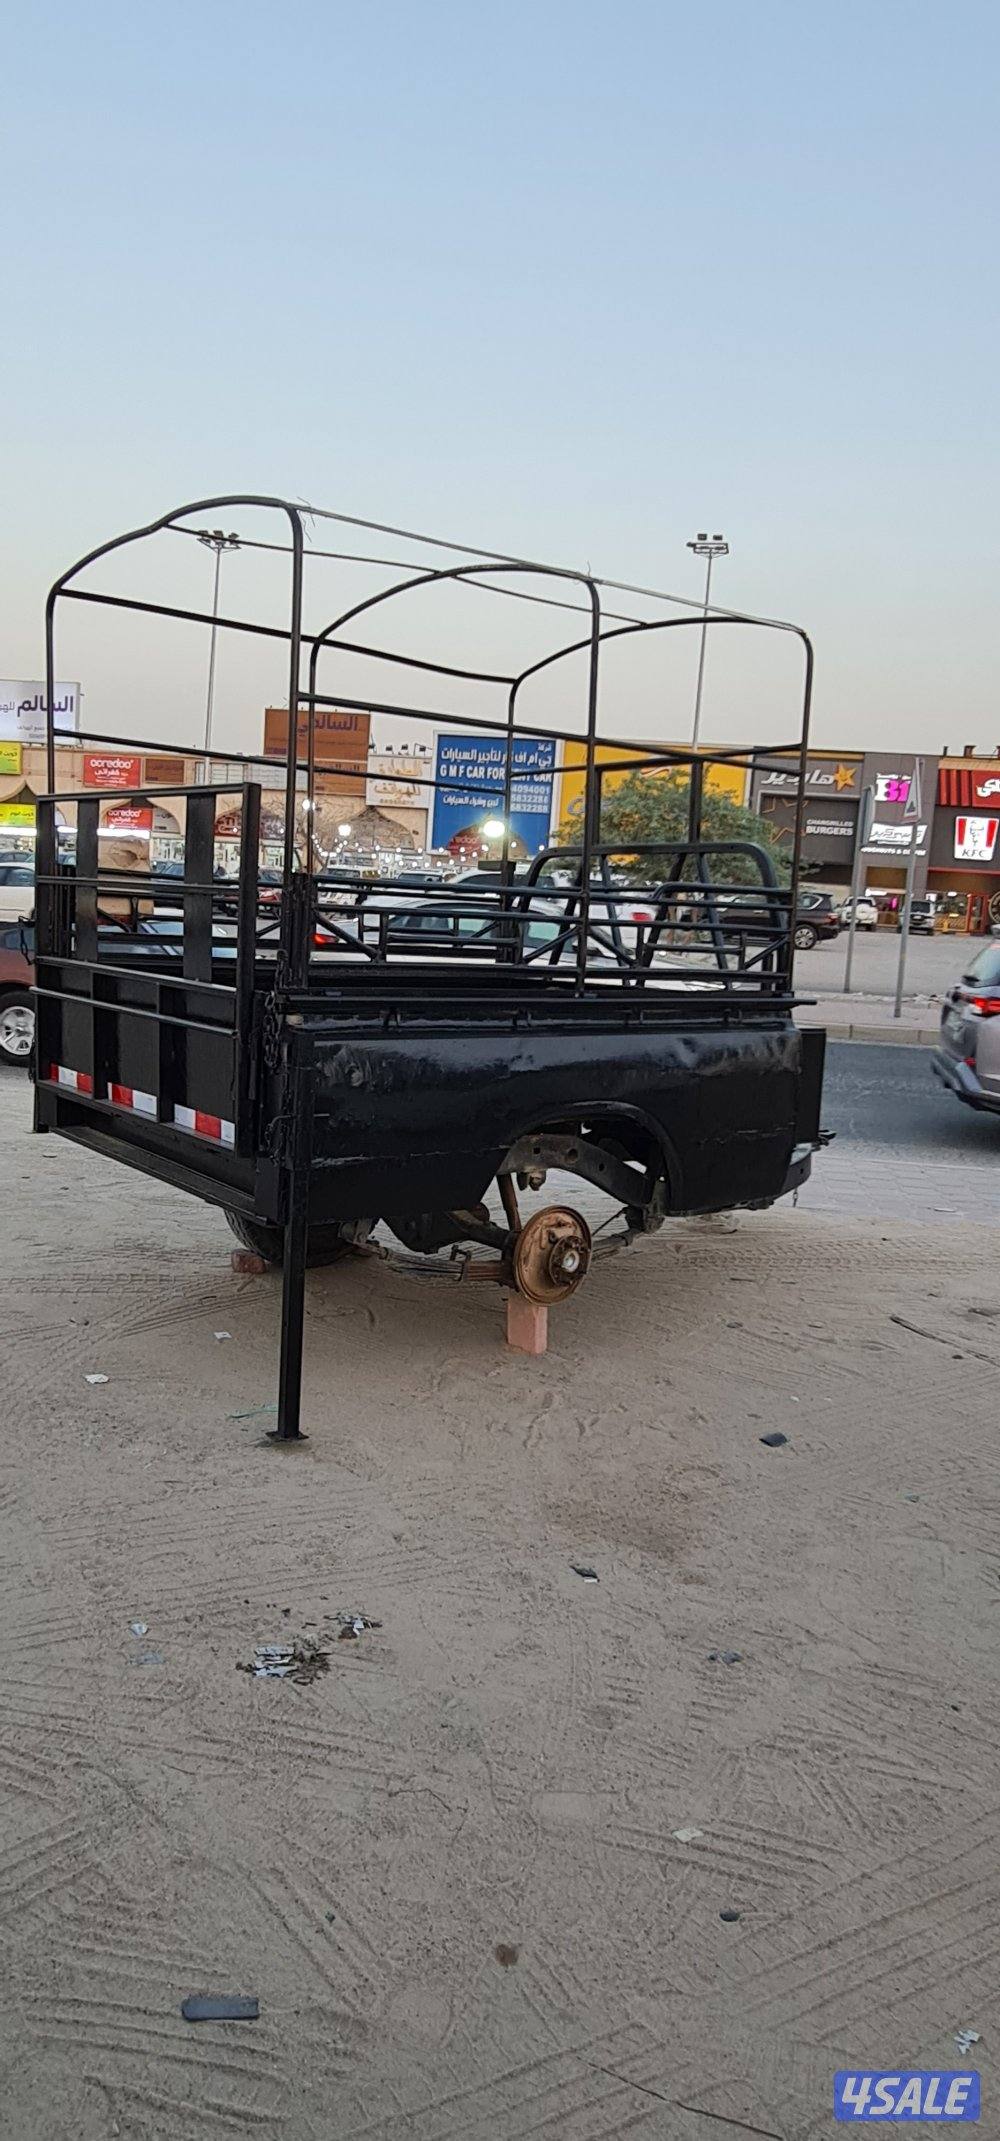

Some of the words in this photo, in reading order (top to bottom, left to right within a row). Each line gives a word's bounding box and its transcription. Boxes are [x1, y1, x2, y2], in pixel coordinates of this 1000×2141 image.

[441, 747, 478, 763] السيارات
[90, 758, 133, 769] ooredoo
[439, 764, 448, 777] G
[449, 765, 458, 777] M
[458, 765, 466, 778] F
[466, 766, 485, 779] CAR
[486, 767, 506, 780] FOR
[805, 827, 853, 836] BURGERS
[962, 848, 985, 858] KFC
